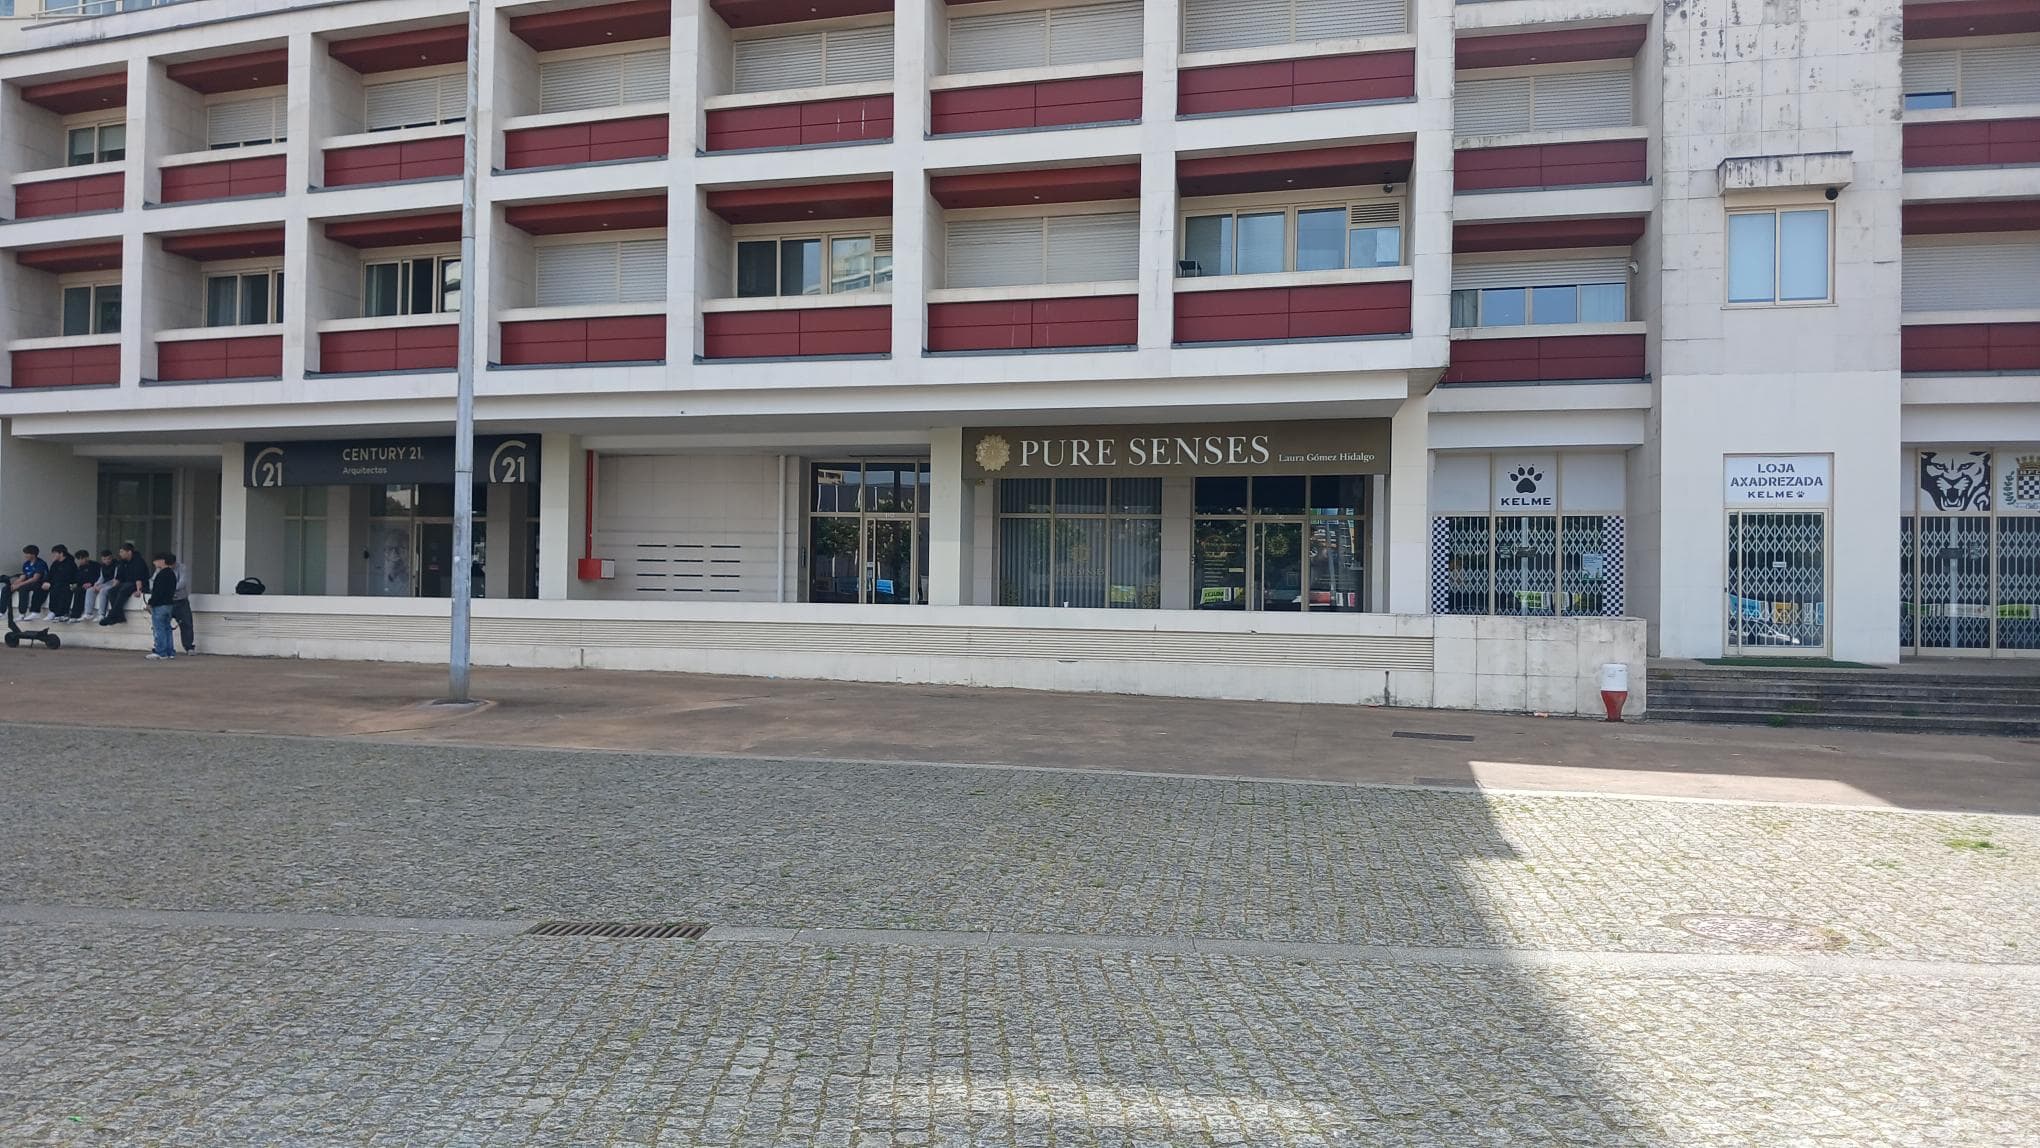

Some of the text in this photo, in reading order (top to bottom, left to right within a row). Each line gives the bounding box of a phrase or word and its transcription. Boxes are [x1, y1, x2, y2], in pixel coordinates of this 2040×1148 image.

[342, 446, 406, 461] CENTURY
[1019, 434, 1375, 467] PURE SENSES Laura Gómez Hidalgo
[1757, 463, 1795, 474] LOJA
[1730, 476, 1824, 487] AXADREZADA
[1747, 491, 1794, 499] KELME
[1500, 497, 1552, 506] KELME
